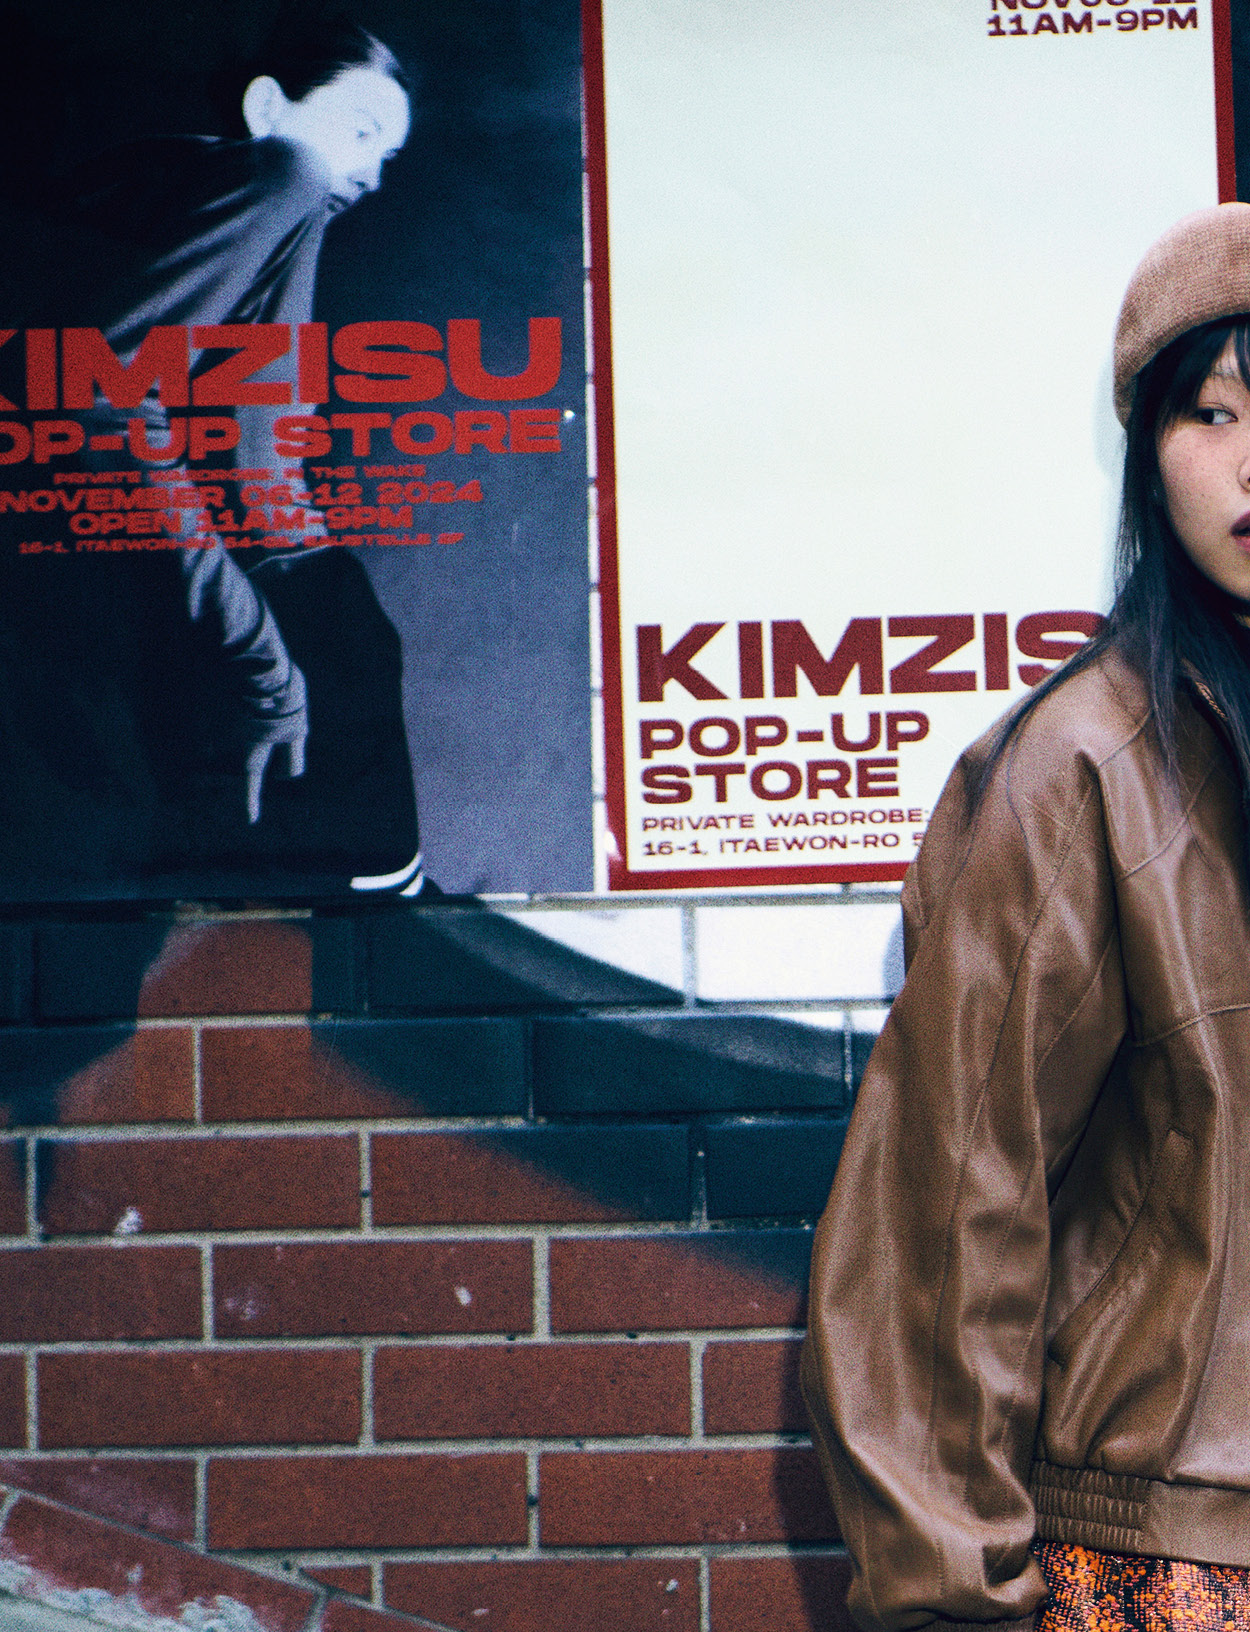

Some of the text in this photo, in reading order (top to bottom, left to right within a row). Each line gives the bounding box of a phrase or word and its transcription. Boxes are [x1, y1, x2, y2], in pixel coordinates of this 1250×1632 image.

[987, 7, 1198, 36] 11AM-9PM
[0, 317, 562, 410] IMZISU
[273, 409, 562, 458] STORE
[310, 465, 356, 479] THE
[362, 464, 426, 478] WAKE
[0, 479, 484, 513] NOVEMBER 06-12 2024
[69, 505, 413, 535] OPEN 11AM-9PM
[635, 610, 1104, 702] KIMZIS
[639, 710, 930, 760] POP-UP
[641, 758, 899, 804] STORE
[641, 812, 755, 831] PRIVATE
[719, 832, 900, 854] ITAEWON-RO
